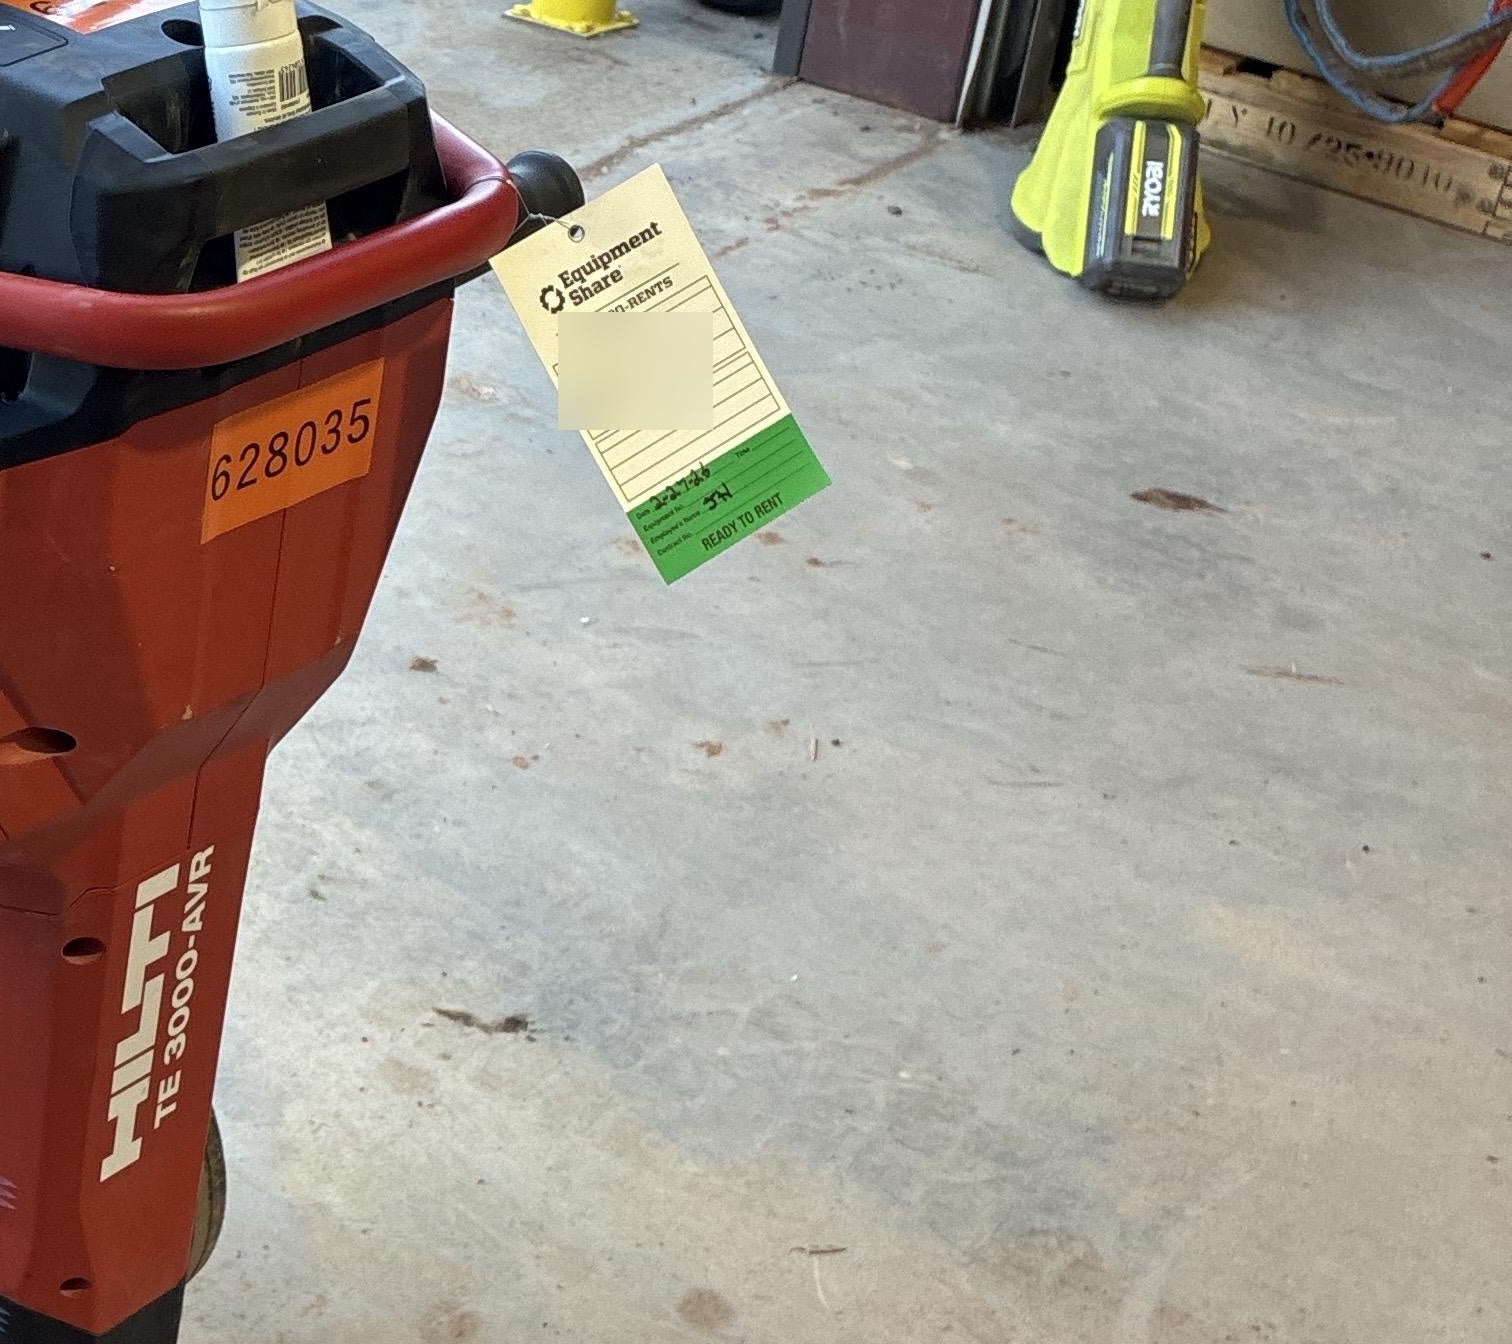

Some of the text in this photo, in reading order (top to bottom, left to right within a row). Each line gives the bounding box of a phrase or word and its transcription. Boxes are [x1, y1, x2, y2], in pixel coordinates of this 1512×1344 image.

[1141, 160, 1165, 217] RYOBI
[557, 221, 663, 289] Equipment
[568, 268, 624, 307] Share
[211, 398, 372, 502] 628035
[700, 491, 785, 552] READY TO RENT
[153, 843, 216, 1130] TE 3000-AVR
[99, 862, 181, 1183] HILTI
